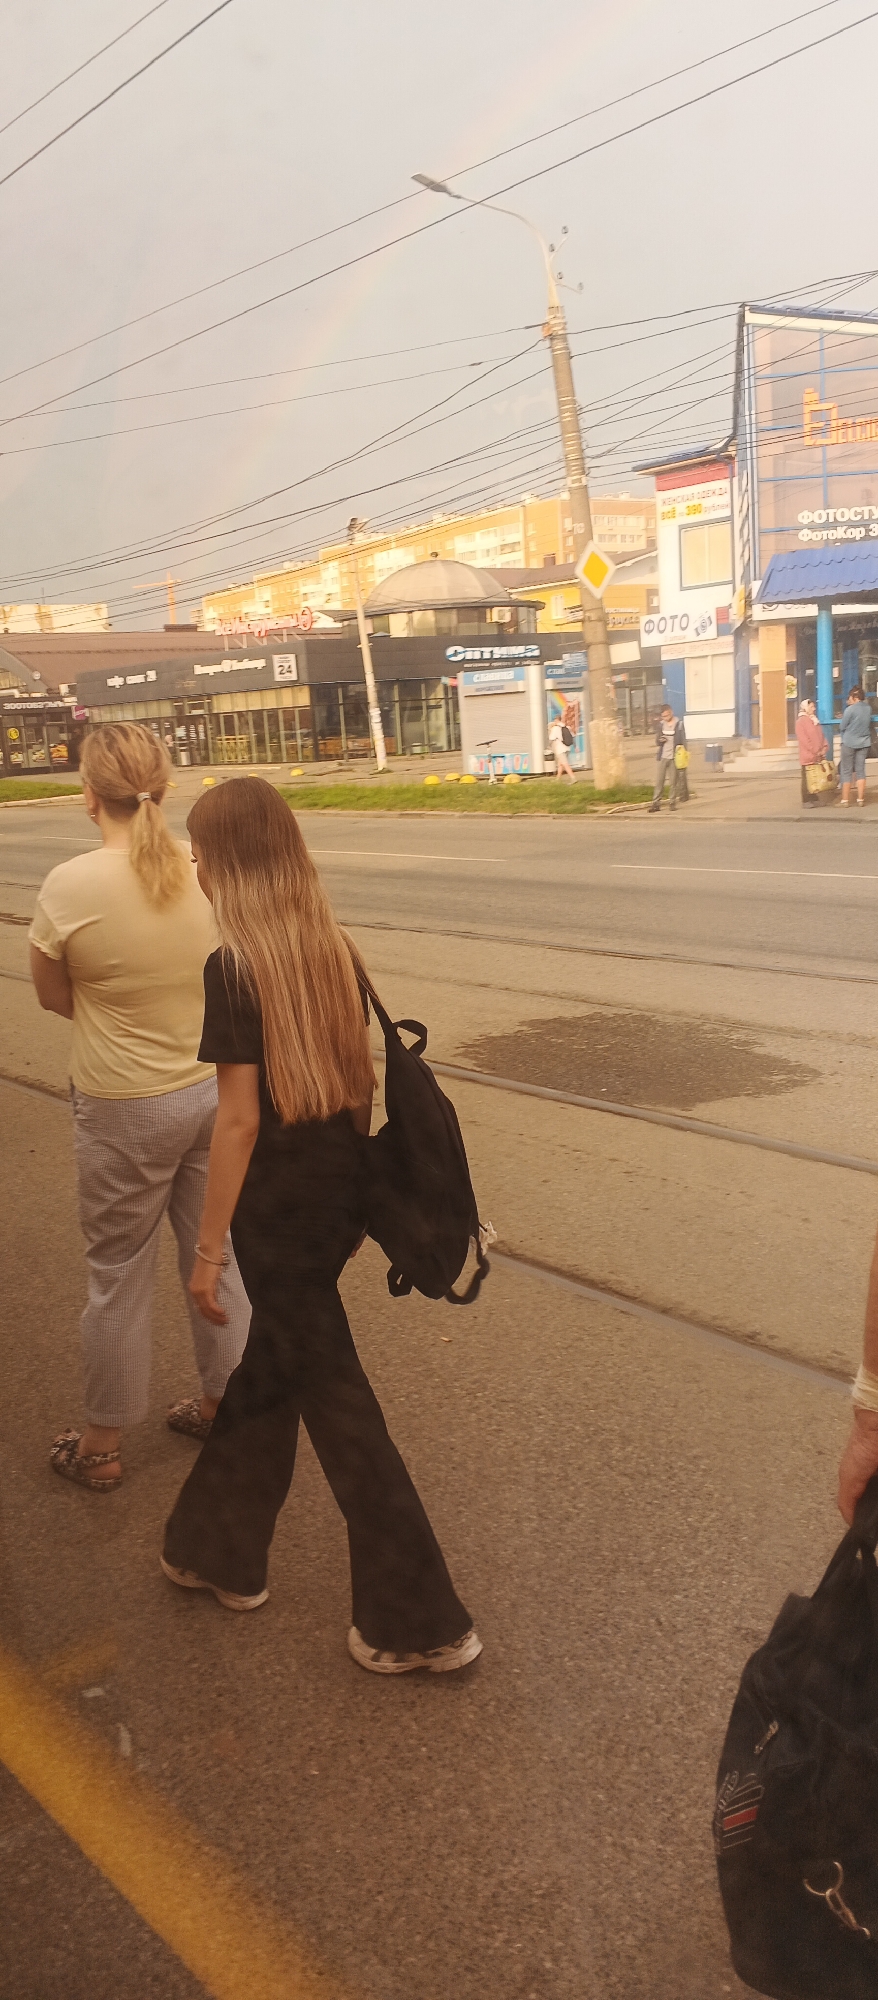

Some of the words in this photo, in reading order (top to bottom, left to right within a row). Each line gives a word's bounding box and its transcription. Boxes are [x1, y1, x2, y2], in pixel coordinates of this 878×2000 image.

[661, 491, 695, 506] ЖЕНСКАЯ
[696, 487, 728, 500] ОДЕЖДА
[797, 528, 866, 542] ФотоКор
[643, 613, 690, 636] ФОТО
[278, 664, 293, 675] 24
